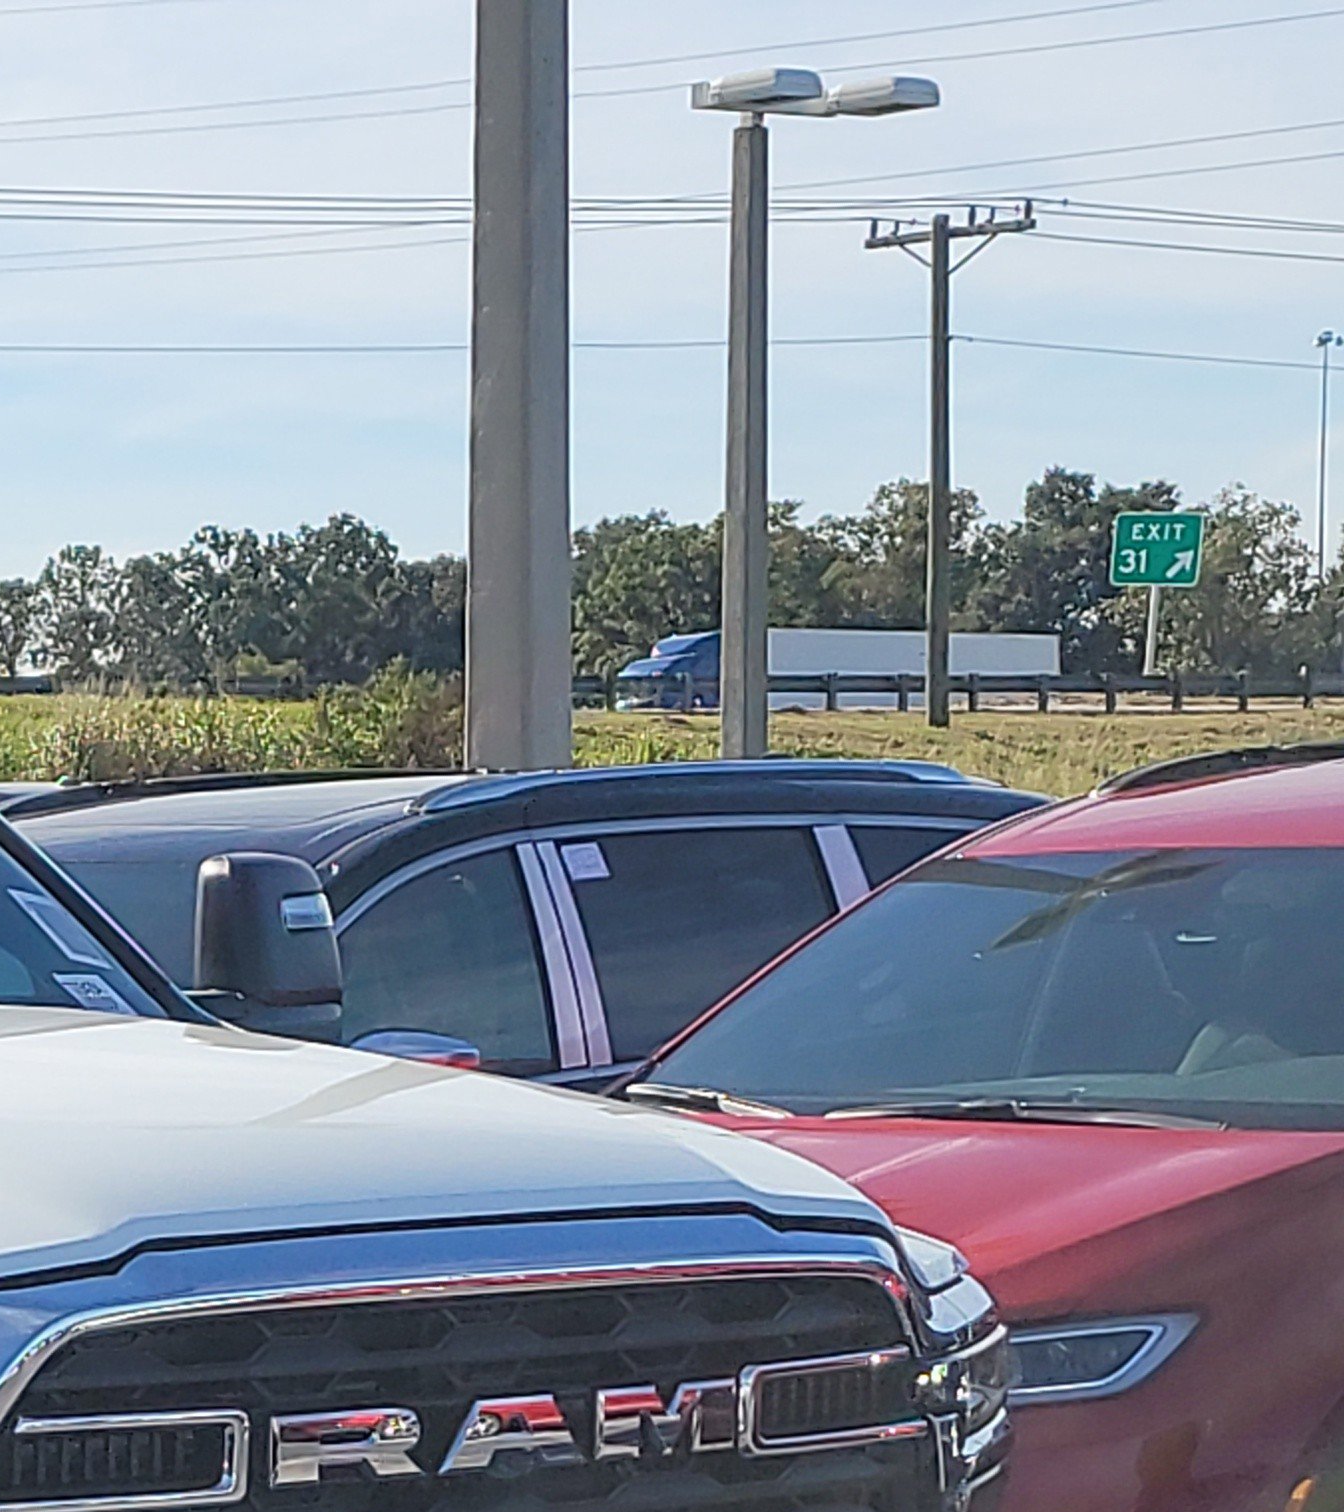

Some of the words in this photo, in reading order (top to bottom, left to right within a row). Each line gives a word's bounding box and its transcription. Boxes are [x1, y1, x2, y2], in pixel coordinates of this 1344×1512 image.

[1131, 523, 1186, 541] EXIT
[1118, 549, 1147, 574] 31
[269, 1378, 737, 1488] RAM
